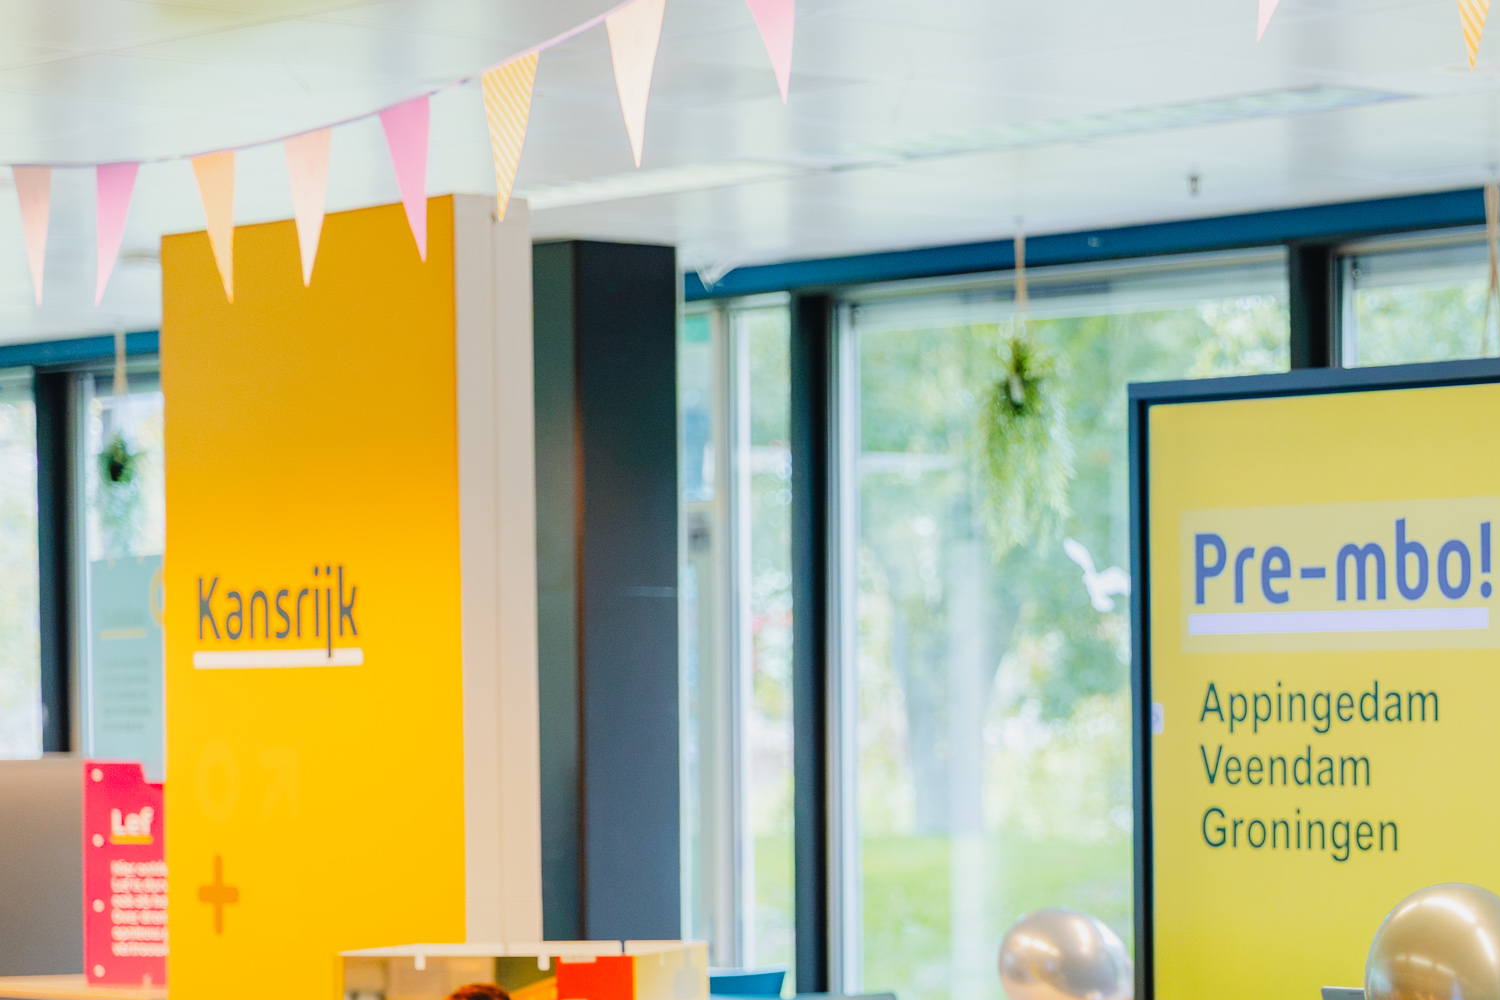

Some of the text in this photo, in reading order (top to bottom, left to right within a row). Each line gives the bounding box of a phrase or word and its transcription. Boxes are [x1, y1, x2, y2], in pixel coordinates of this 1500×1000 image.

[1194, 517, 1493, 605] Pre-mbo!
[197, 564, 359, 659] Kansrijk
[1200, 680, 1440, 733] Appingedam
[1200, 744, 1371, 786] Veendam
[1202, 807, 1399, 862] Groningen
